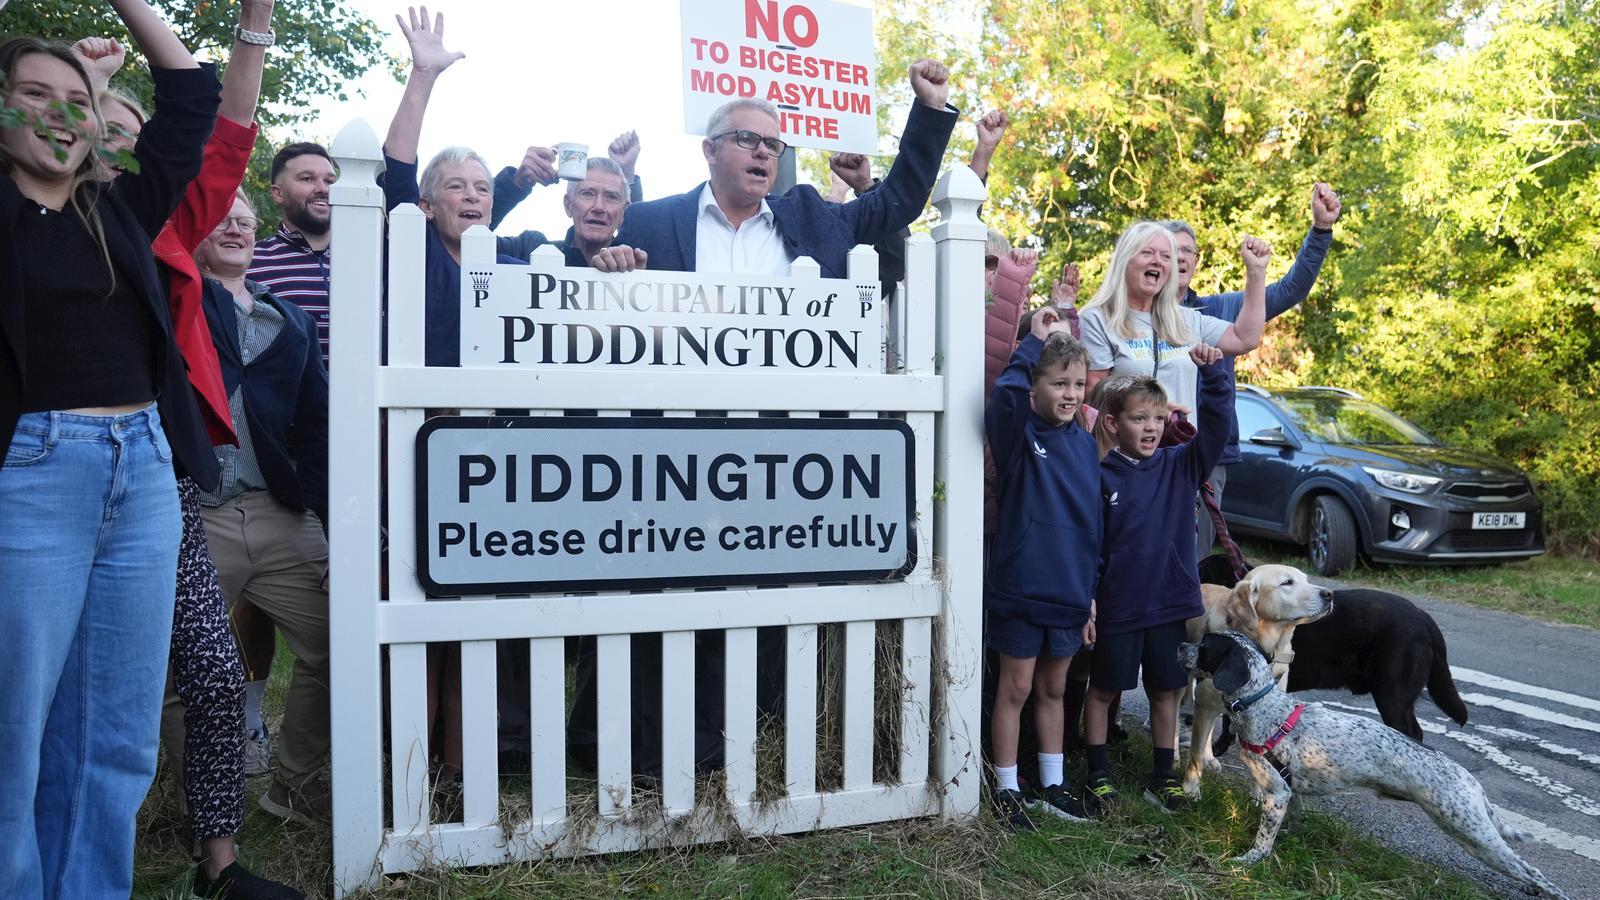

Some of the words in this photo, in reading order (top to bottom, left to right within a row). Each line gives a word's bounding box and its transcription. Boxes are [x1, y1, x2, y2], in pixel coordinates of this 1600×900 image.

[745, 0, 819, 48] NO
[690, 37, 729, 64] TO
[740, 46, 868, 86] BICESTER
[691, 69, 756, 98] MOD
[767, 81, 871, 115] ASYLUM
[527, 272, 796, 317] PRINCIPALITY
[806, 293, 838, 317] of
[498, 315, 862, 368] PIDDINGTON
[459, 453, 880, 503] PIDDINGTON
[438, 522, 585, 557] Please
[598, 518, 705, 554] drive
[718, 514, 897, 553] carefully
[1478, 514, 1500, 527] KE18
[1502, 514, 1519, 526] DWL
